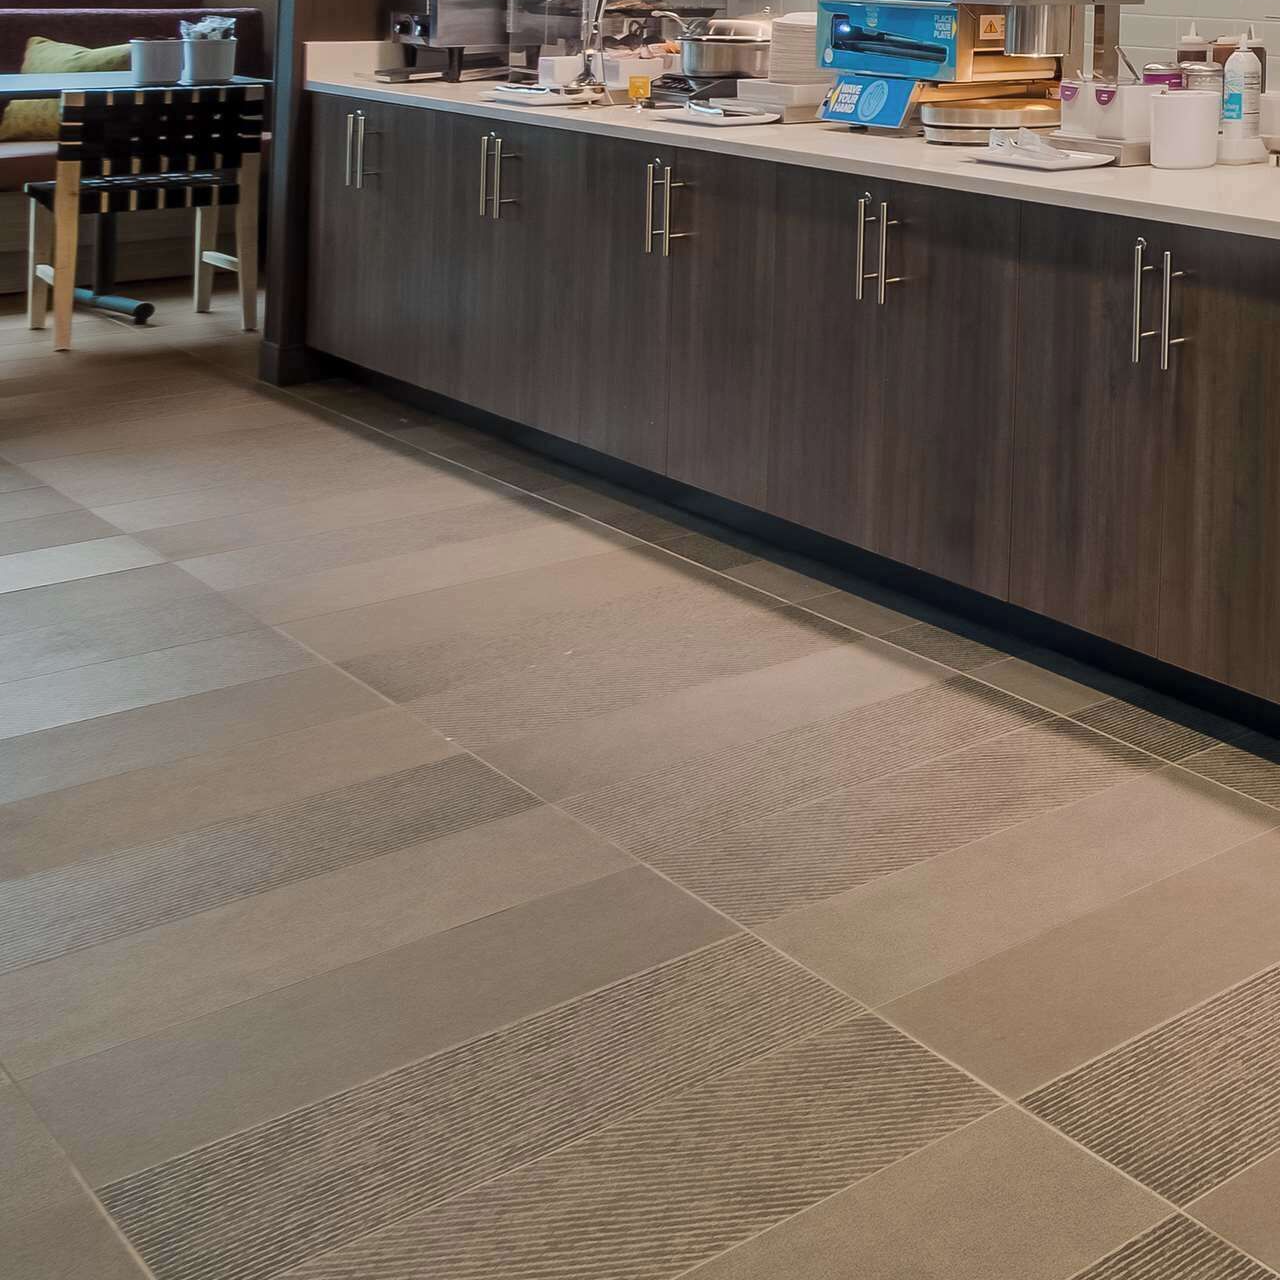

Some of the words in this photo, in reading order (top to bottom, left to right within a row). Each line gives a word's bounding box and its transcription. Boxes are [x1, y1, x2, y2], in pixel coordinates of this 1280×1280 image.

[935, 22, 952, 30] YOUR
[933, 31, 951, 39] PLATE
[841, 84, 863, 94] WAVE
[838, 94, 859, 104] YOUR
[832, 103, 856, 113] HAND
